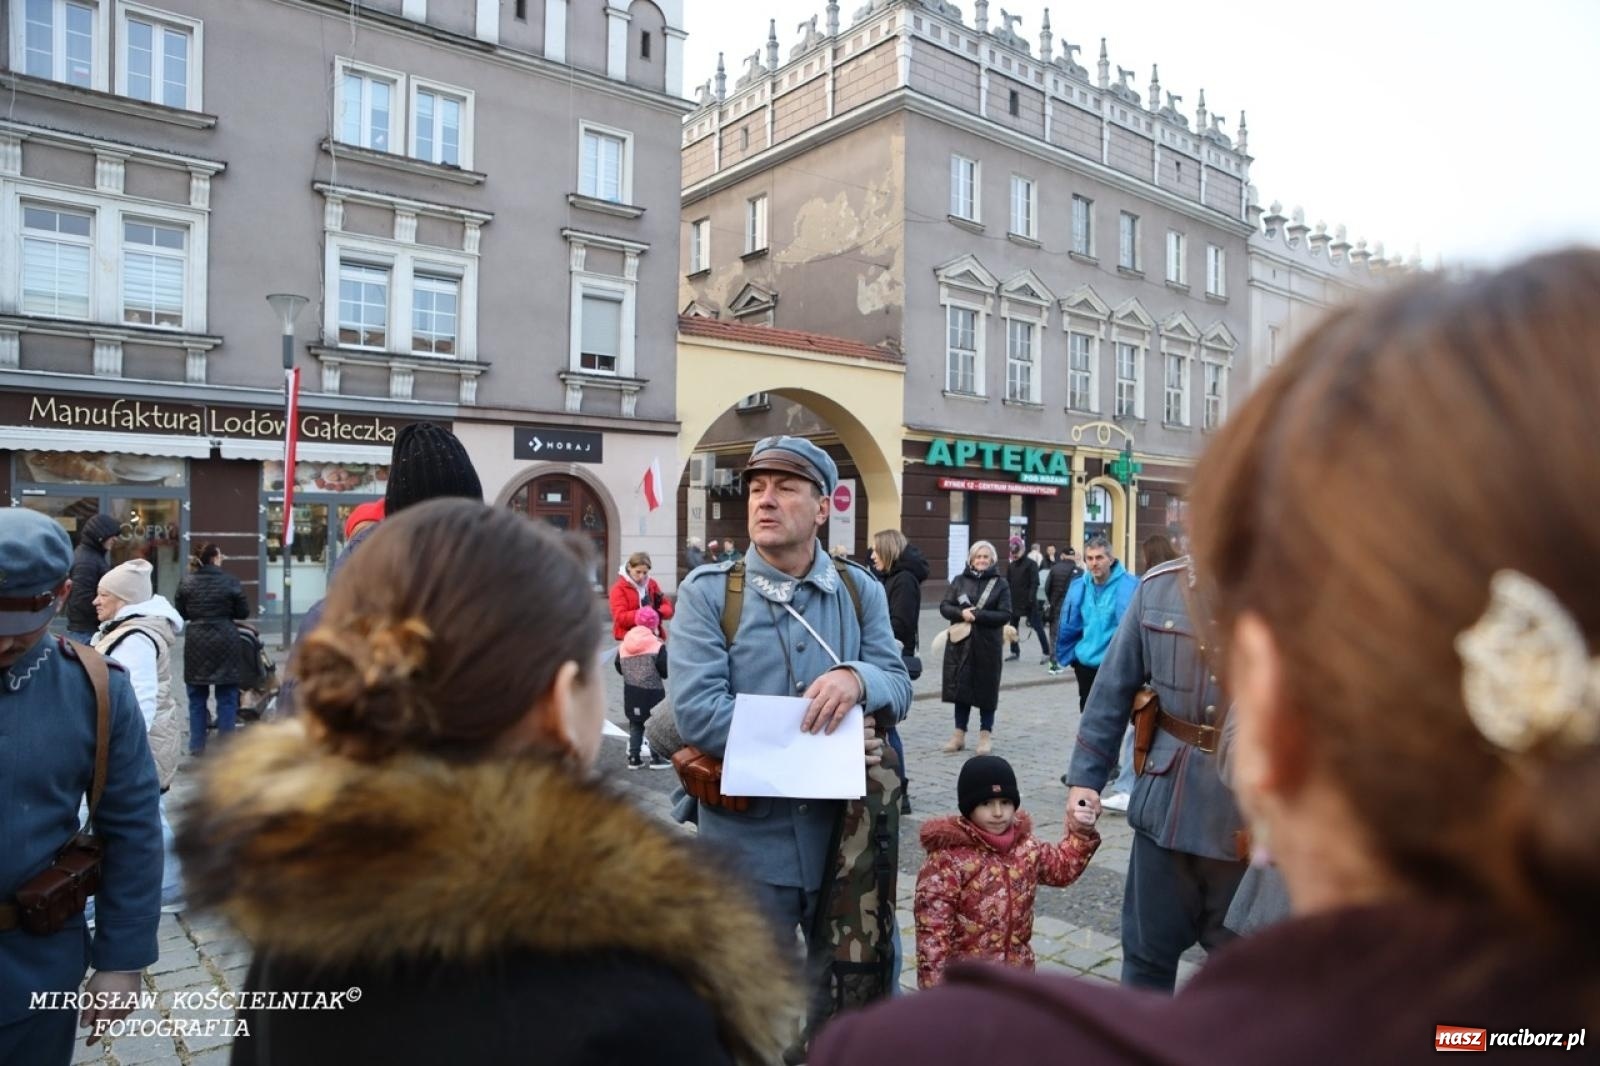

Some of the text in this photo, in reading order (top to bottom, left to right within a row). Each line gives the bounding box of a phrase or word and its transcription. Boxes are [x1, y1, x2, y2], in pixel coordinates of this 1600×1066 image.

[29, 396, 396, 443] Manufaktura Lodów Gałeczka
[926, 437, 1069, 475] APTEKA
